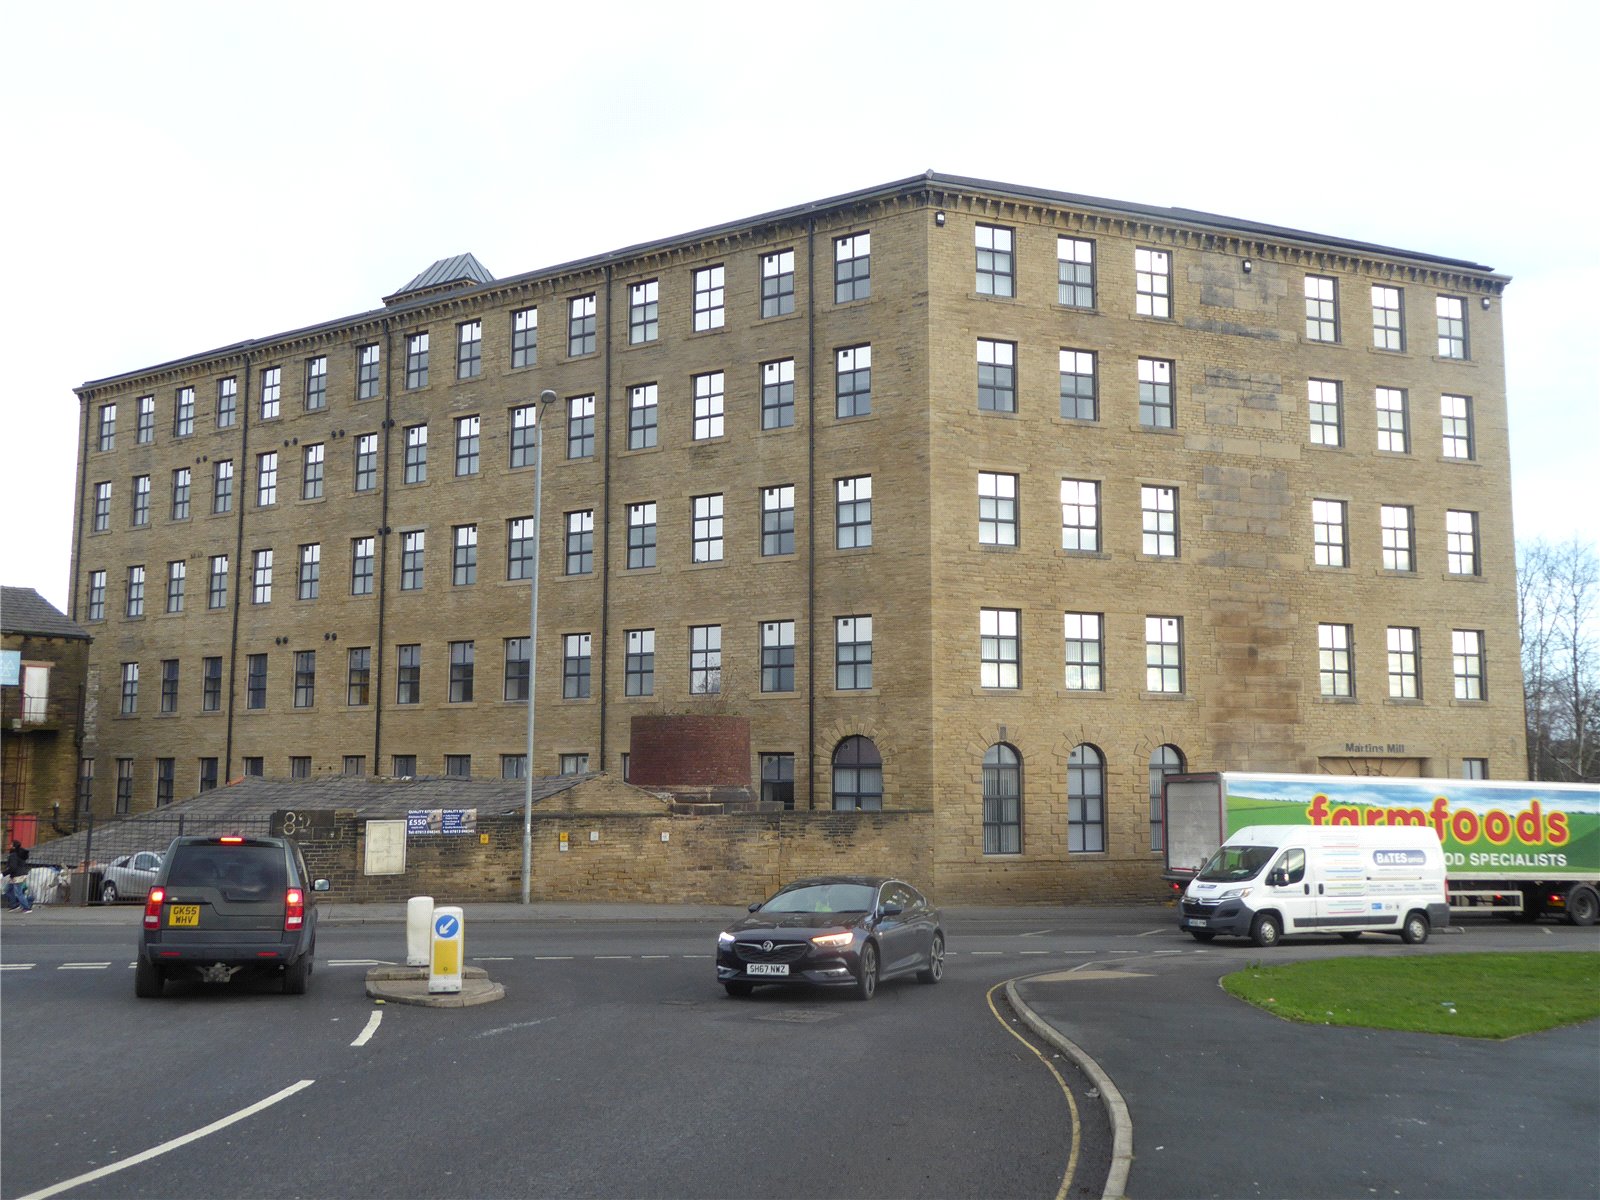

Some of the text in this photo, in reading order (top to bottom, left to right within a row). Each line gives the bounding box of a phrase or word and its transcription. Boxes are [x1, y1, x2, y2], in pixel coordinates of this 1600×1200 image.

[1345, 743, 1405, 753] Martins Mill
[1376, 852, 1408, 864] BATES
[1444, 852, 1568, 867] OD SPECIALISTS
[173, 906, 197, 915] GK55
[175, 916, 193, 924] WHV
[750, 964, 786, 974] SH67 NWZ
